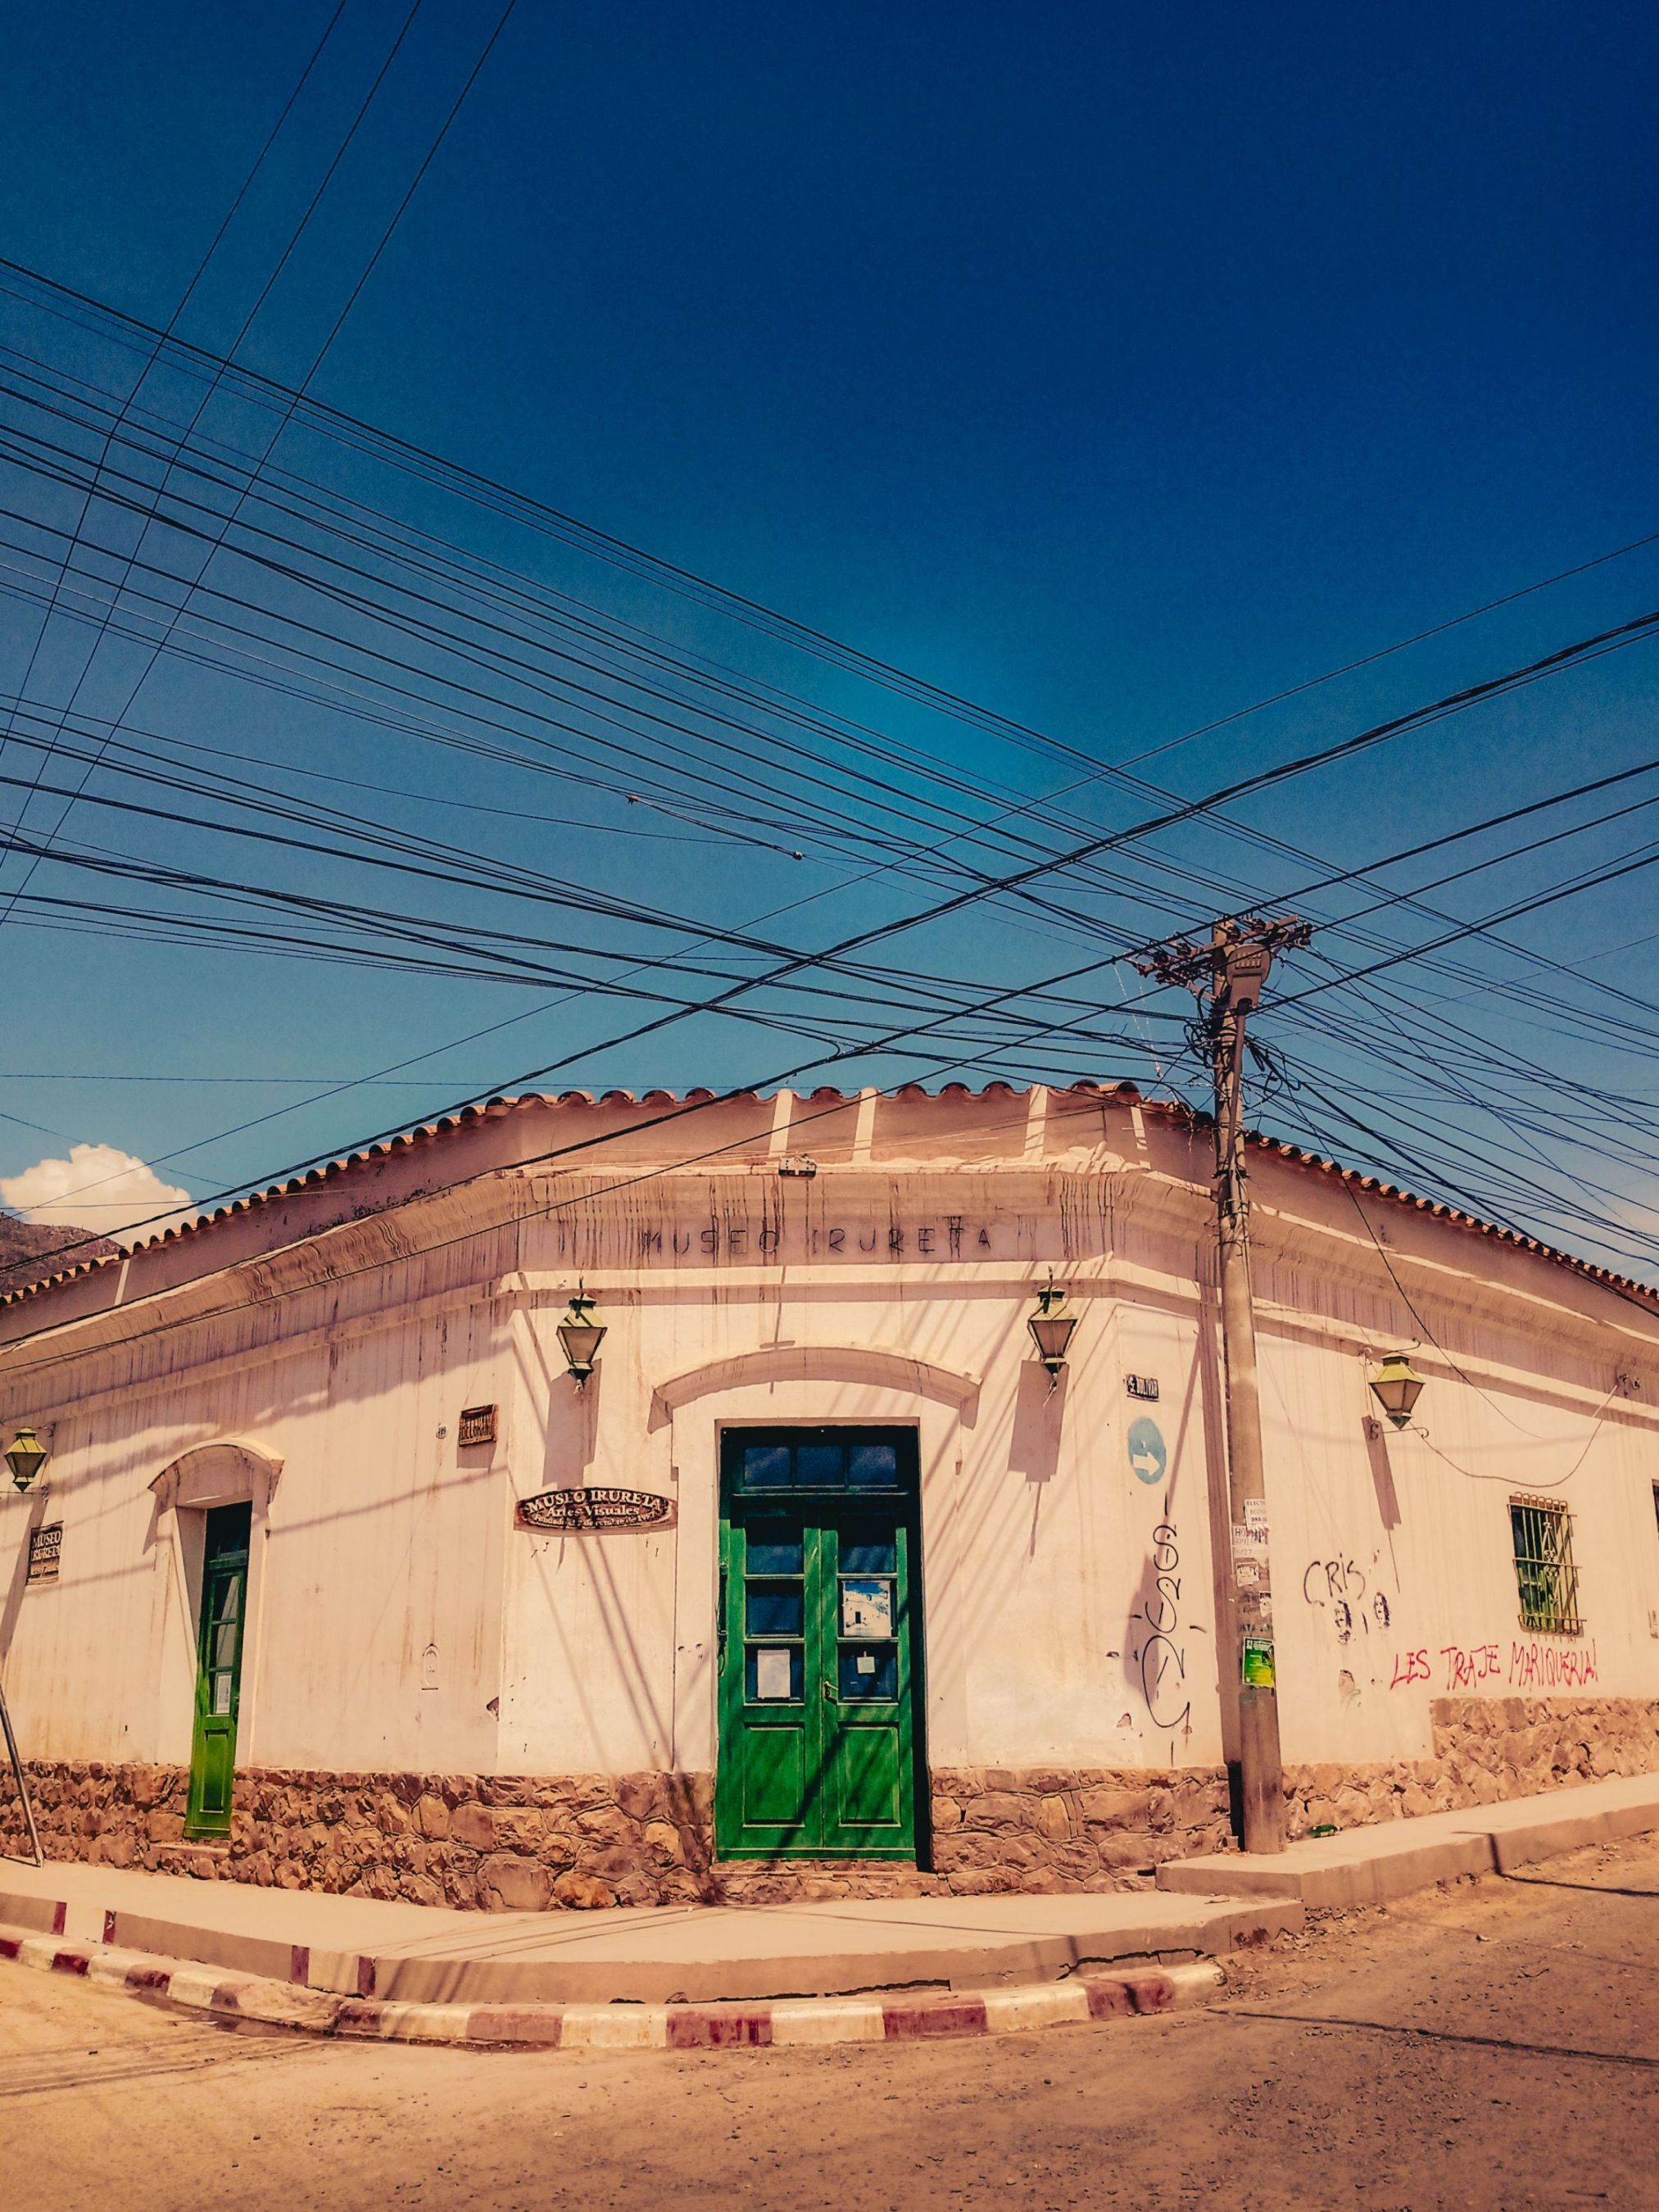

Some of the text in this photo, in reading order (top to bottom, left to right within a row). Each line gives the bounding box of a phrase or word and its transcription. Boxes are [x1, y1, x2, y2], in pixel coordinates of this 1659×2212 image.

[641, 1226, 992, 1255] MUSEO IRURETA
[526, 1489, 663, 1514] MUSEO IRURETA
[585, 1503, 640, 1516] Visuales
[34, 1531, 61, 1548] MUSEO
[1303, 1559, 1366, 1607] CRIS
[1389, 1649, 1430, 1690] LES
